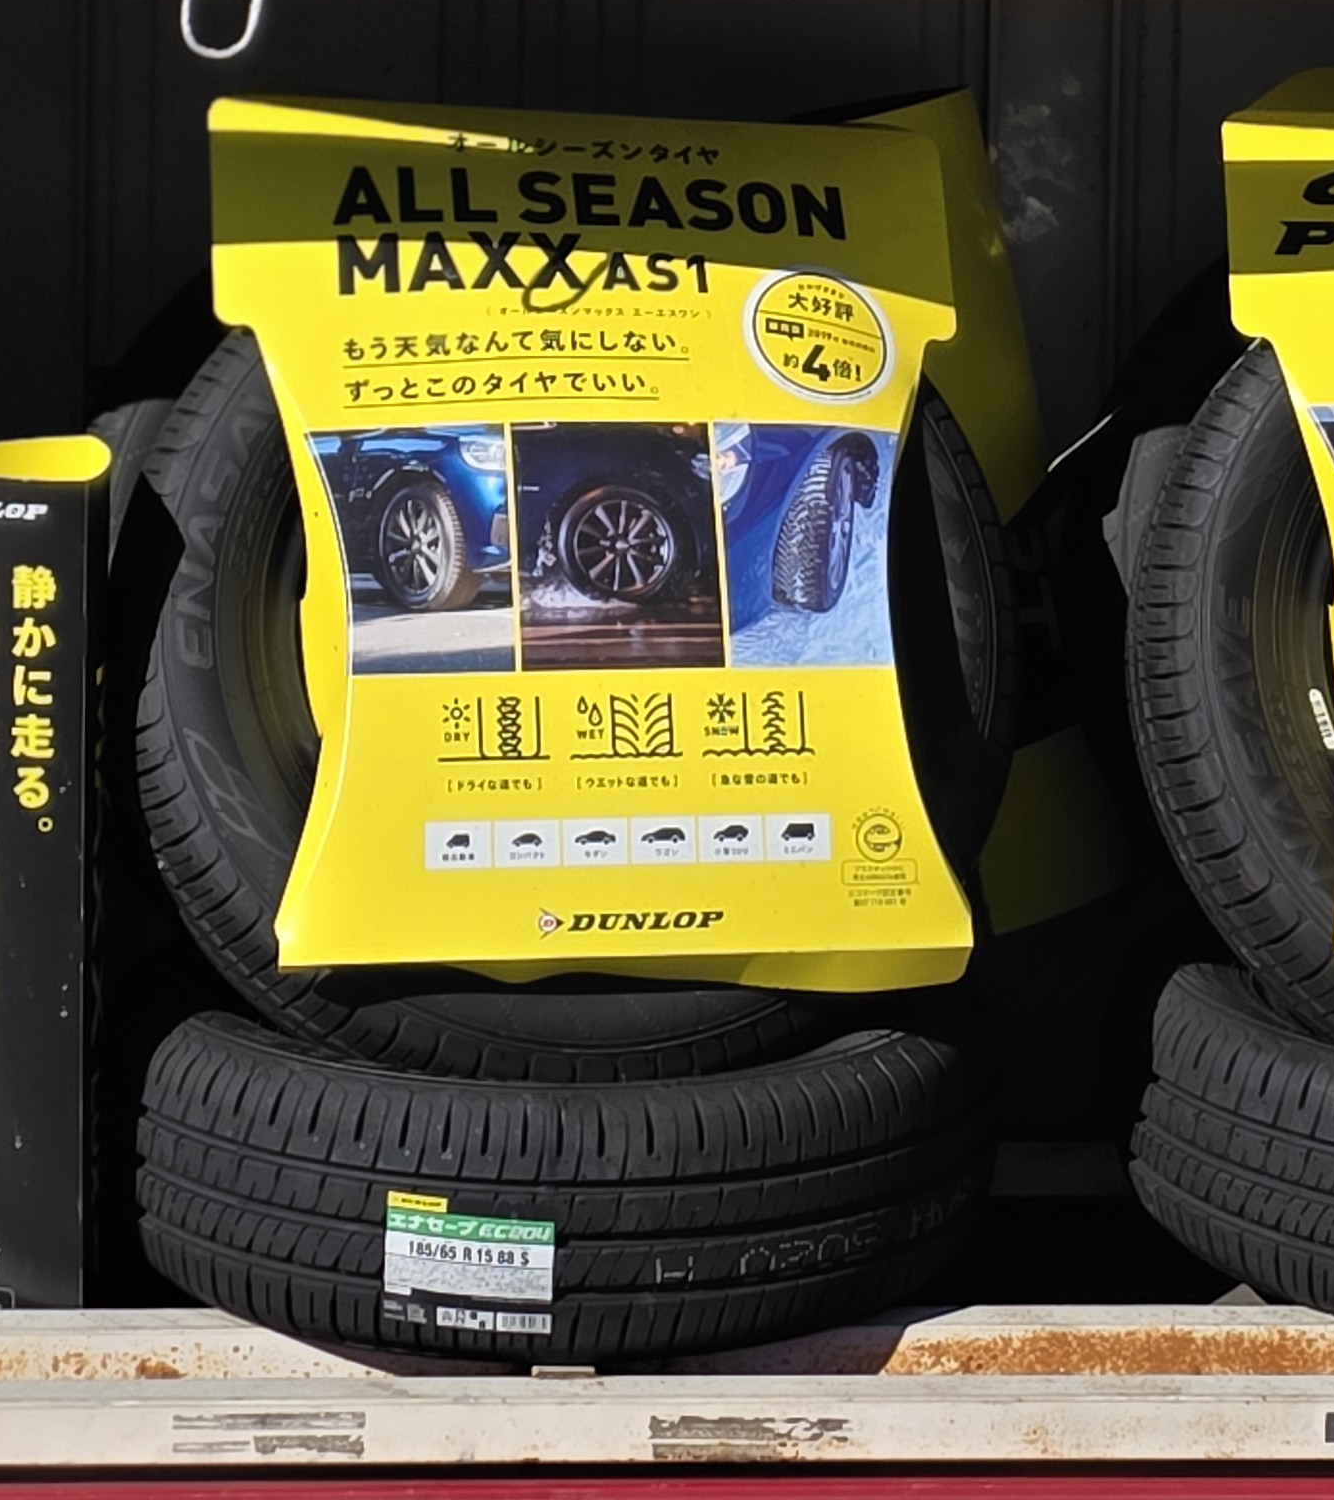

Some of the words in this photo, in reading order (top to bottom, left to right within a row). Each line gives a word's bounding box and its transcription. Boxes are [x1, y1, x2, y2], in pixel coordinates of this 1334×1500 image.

[333, 165, 499, 226] ALL
[517, 170, 848, 240] SEASON
[338, 232, 583, 296] MAXX
[602, 252, 711, 294] AS1
[788, 293, 854, 322] 大好評
[344, 329, 689, 360] もう天気なんて気にしない。
[345, 371, 659, 401] ずっとこのタイヤでいい。
[10, 564, 58, 834] 静かに走る。
[567, 911, 724, 932] DUNLOP
[389, 1213, 478, 1235] エナセーブ
[478, 1223, 551, 1240] EC204
[408, 1240, 457, 1259] 185/65
[463, 1246, 472, 1261] R
[477, 1248, 493, 1264] 15
[520, 1252, 530, 1266] S
